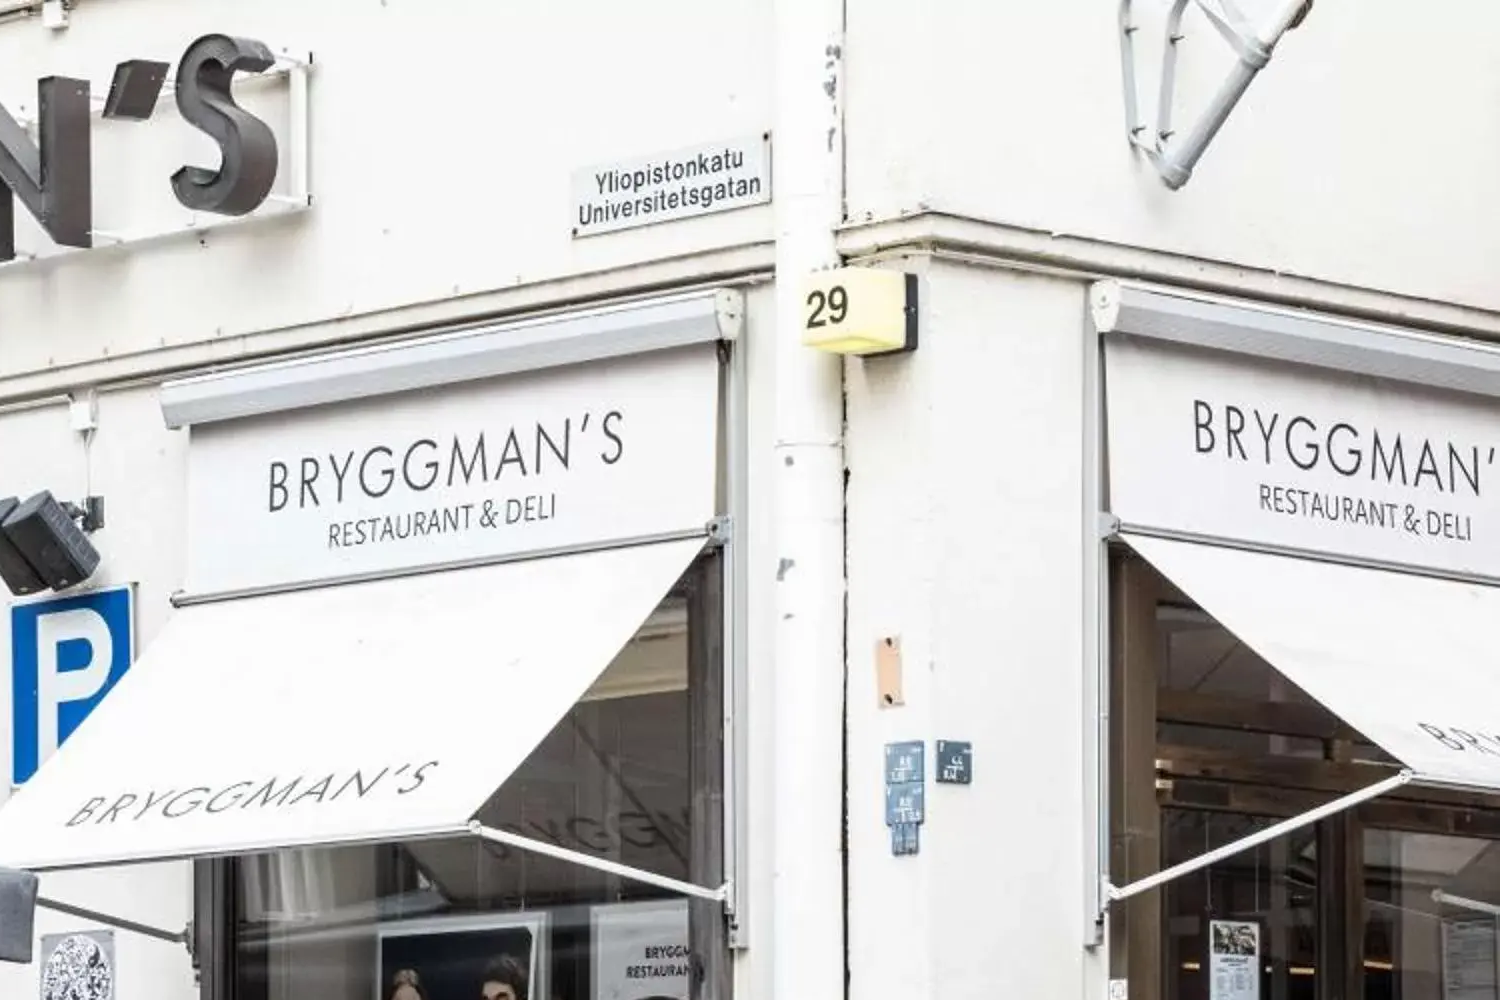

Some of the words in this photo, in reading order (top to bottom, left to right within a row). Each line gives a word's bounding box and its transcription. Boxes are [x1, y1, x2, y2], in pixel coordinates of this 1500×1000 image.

[594, 148, 744, 196] Yliopistonkatu
[578, 176, 762, 226] Universitetsgatan
[806, 285, 848, 329] 29
[268, 410, 624, 513] BRYGGMAN'S
[328, 504, 474, 549] RESTAURANT
[479, 500, 498, 528] &
[506, 494, 555, 526] DELI
[1259, 484, 1398, 531] RESTAURANT
[1403, 504, 1422, 536] &
[1427, 509, 1472, 542] DELI
[37, 608, 114, 749] P
[65, 760, 440, 829] BRYGGMAN'S
